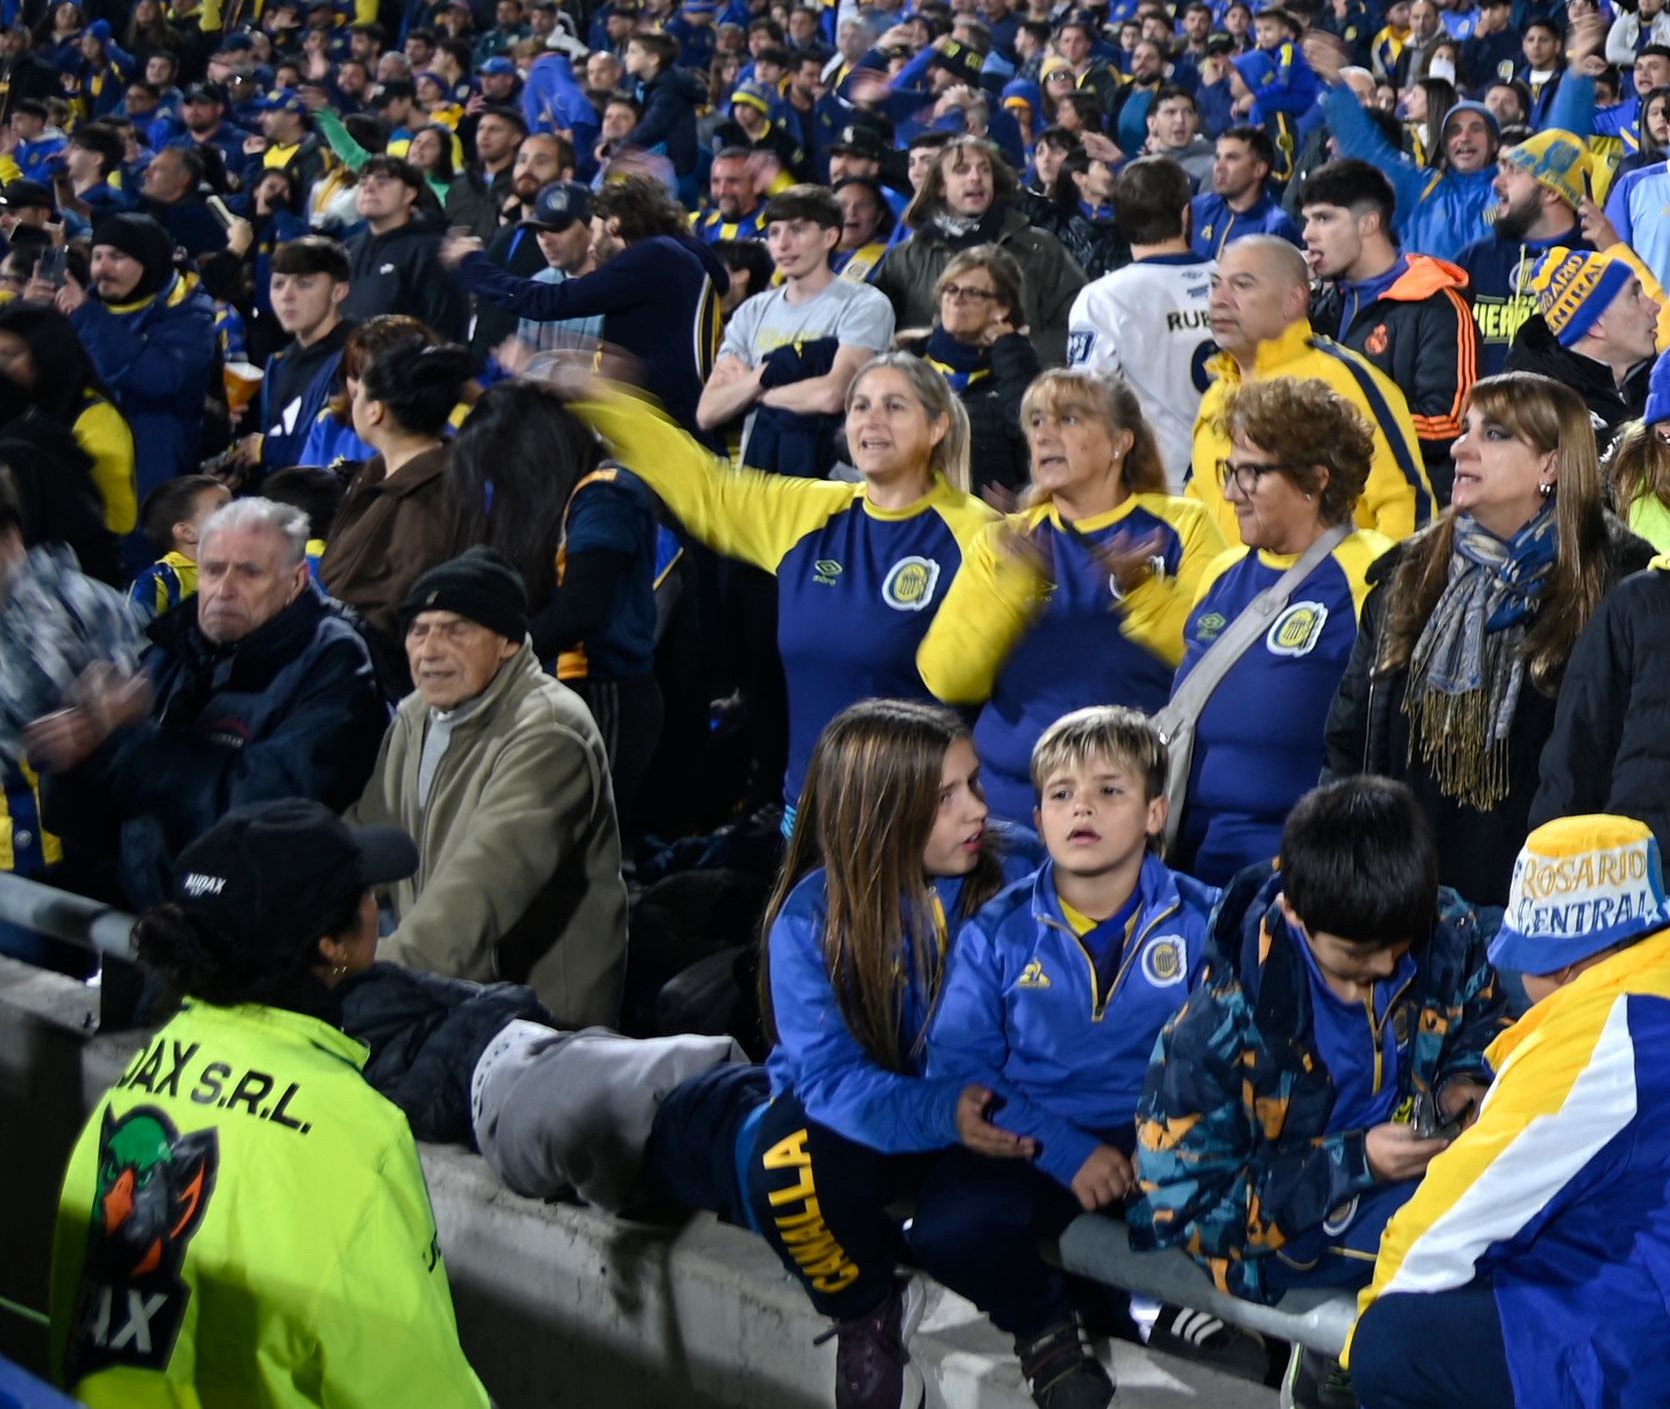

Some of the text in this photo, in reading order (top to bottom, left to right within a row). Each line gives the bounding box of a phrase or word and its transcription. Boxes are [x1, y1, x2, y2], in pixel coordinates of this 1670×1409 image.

[1521, 849, 1646, 900] ROSARIO
[1517, 890, 1648, 938] CENTRAL
[762, 1127, 861, 1294] CANALLA
